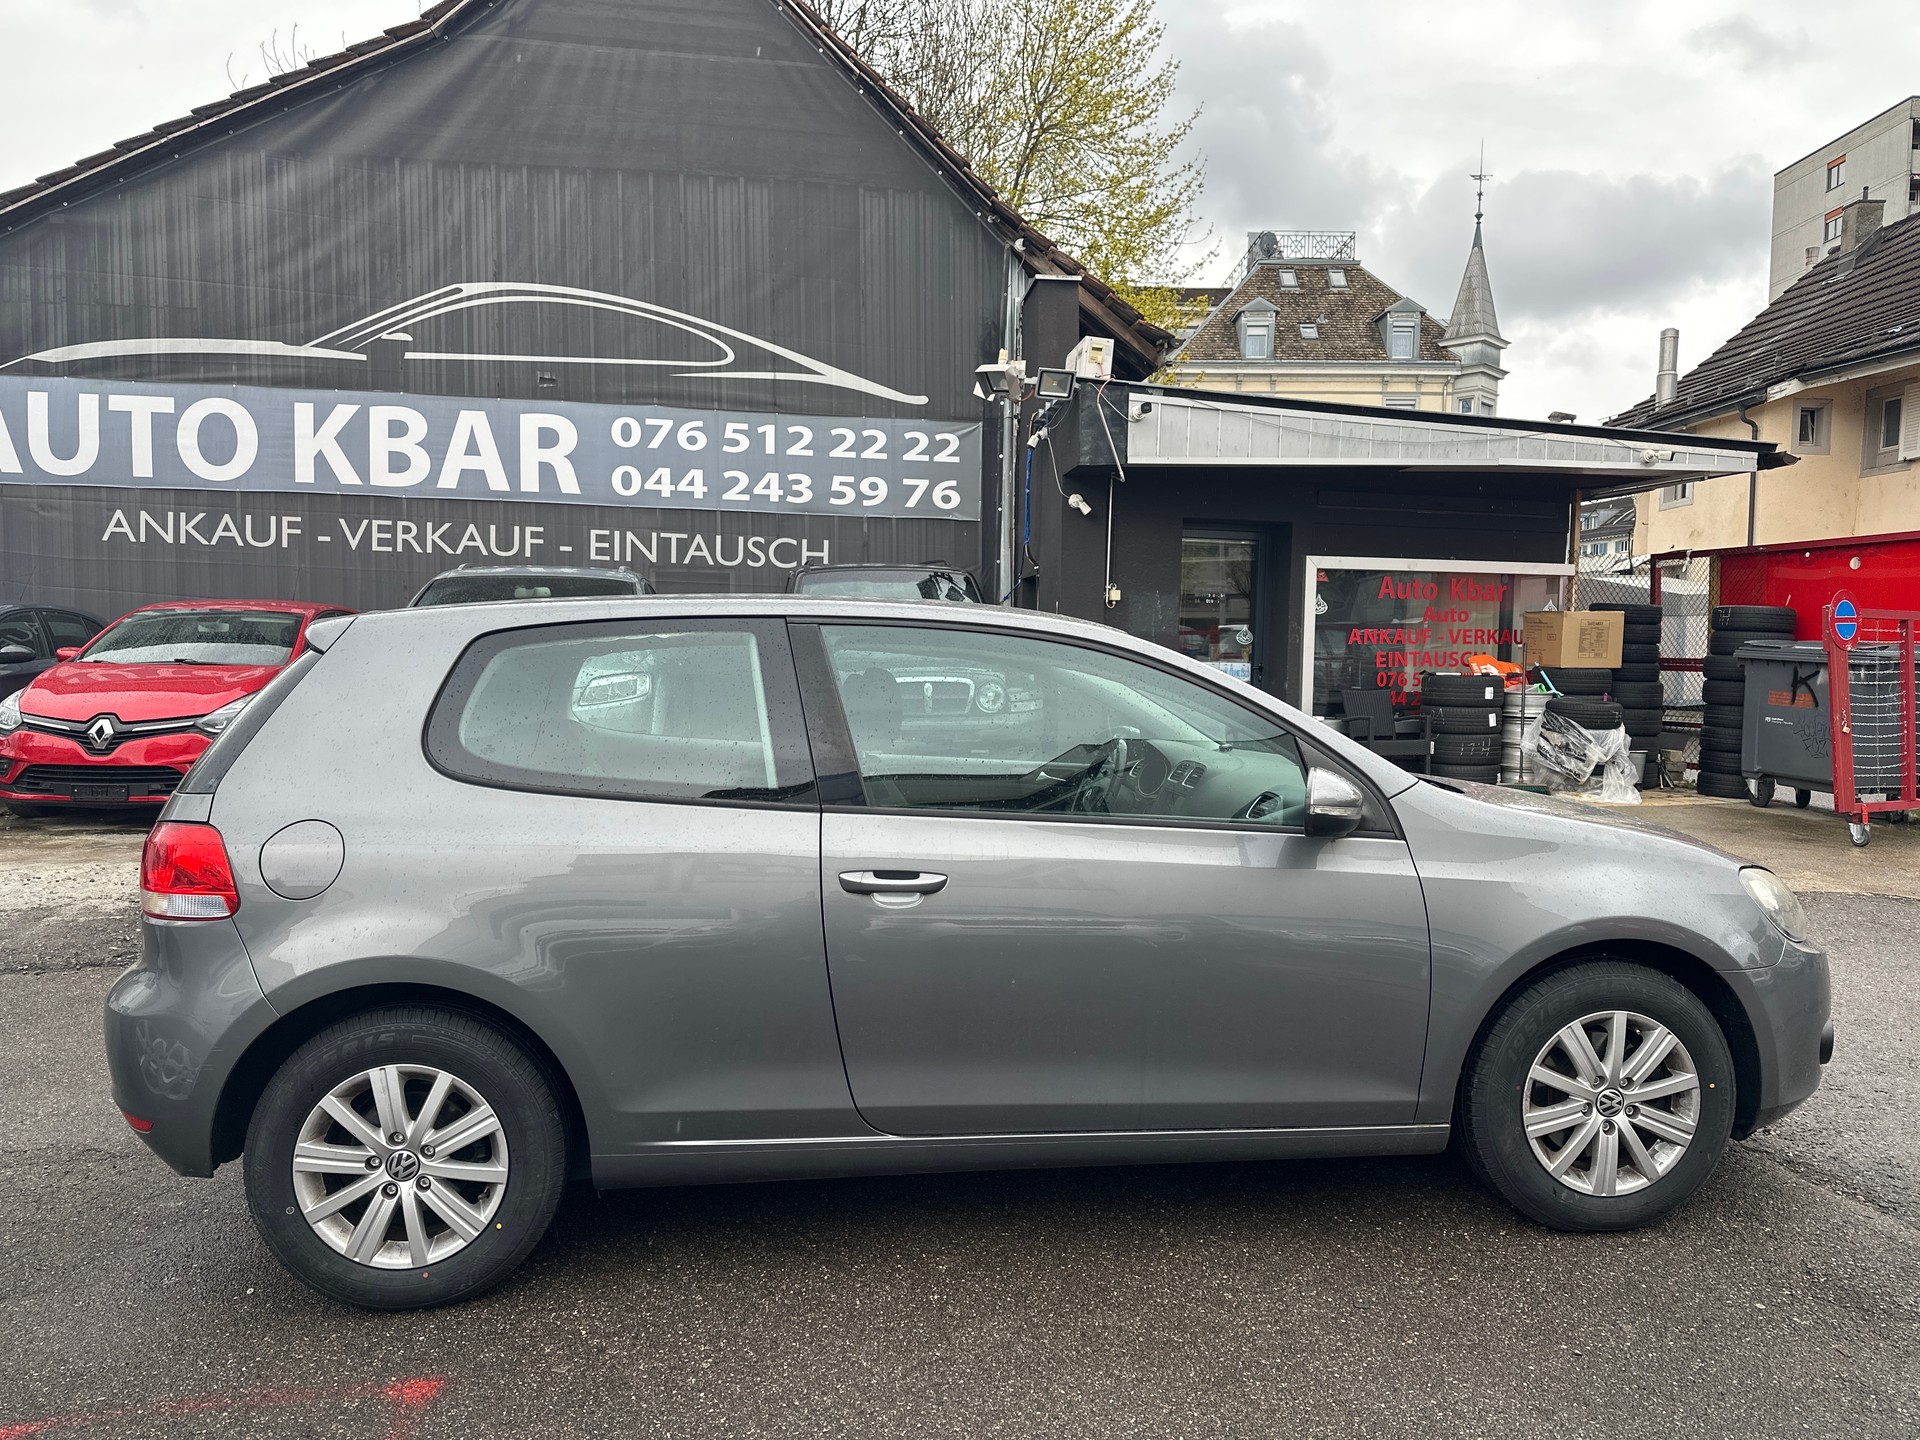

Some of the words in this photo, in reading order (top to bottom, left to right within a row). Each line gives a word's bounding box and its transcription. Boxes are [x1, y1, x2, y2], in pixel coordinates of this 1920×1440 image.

[293, 401, 582, 495] KBAR
[610, 416, 708, 452] 076
[722, 422, 814, 457] 512
[828, 427, 888, 460] 22
[902, 430, 961, 463] 22
[611, 465, 708, 499] 044
[721, 470, 814, 504] 243
[828, 475, 889, 507] 59
[902, 478, 961, 510] 76
[101, 508, 302, 548] ANKAUF
[338, 518, 544, 558] VERKAUF
[589, 529, 829, 569] EINTAUSCH
[1378, 575, 1438, 601] Auto
[1449, 577, 1508, 603] Kbar
[1423, 606, 1470, 623] Auto
[1347, 627, 1432, 645] ANKAUF
[1375, 650, 1487, 669] EINTAUSC
[1376, 671, 1408, 688] 076
